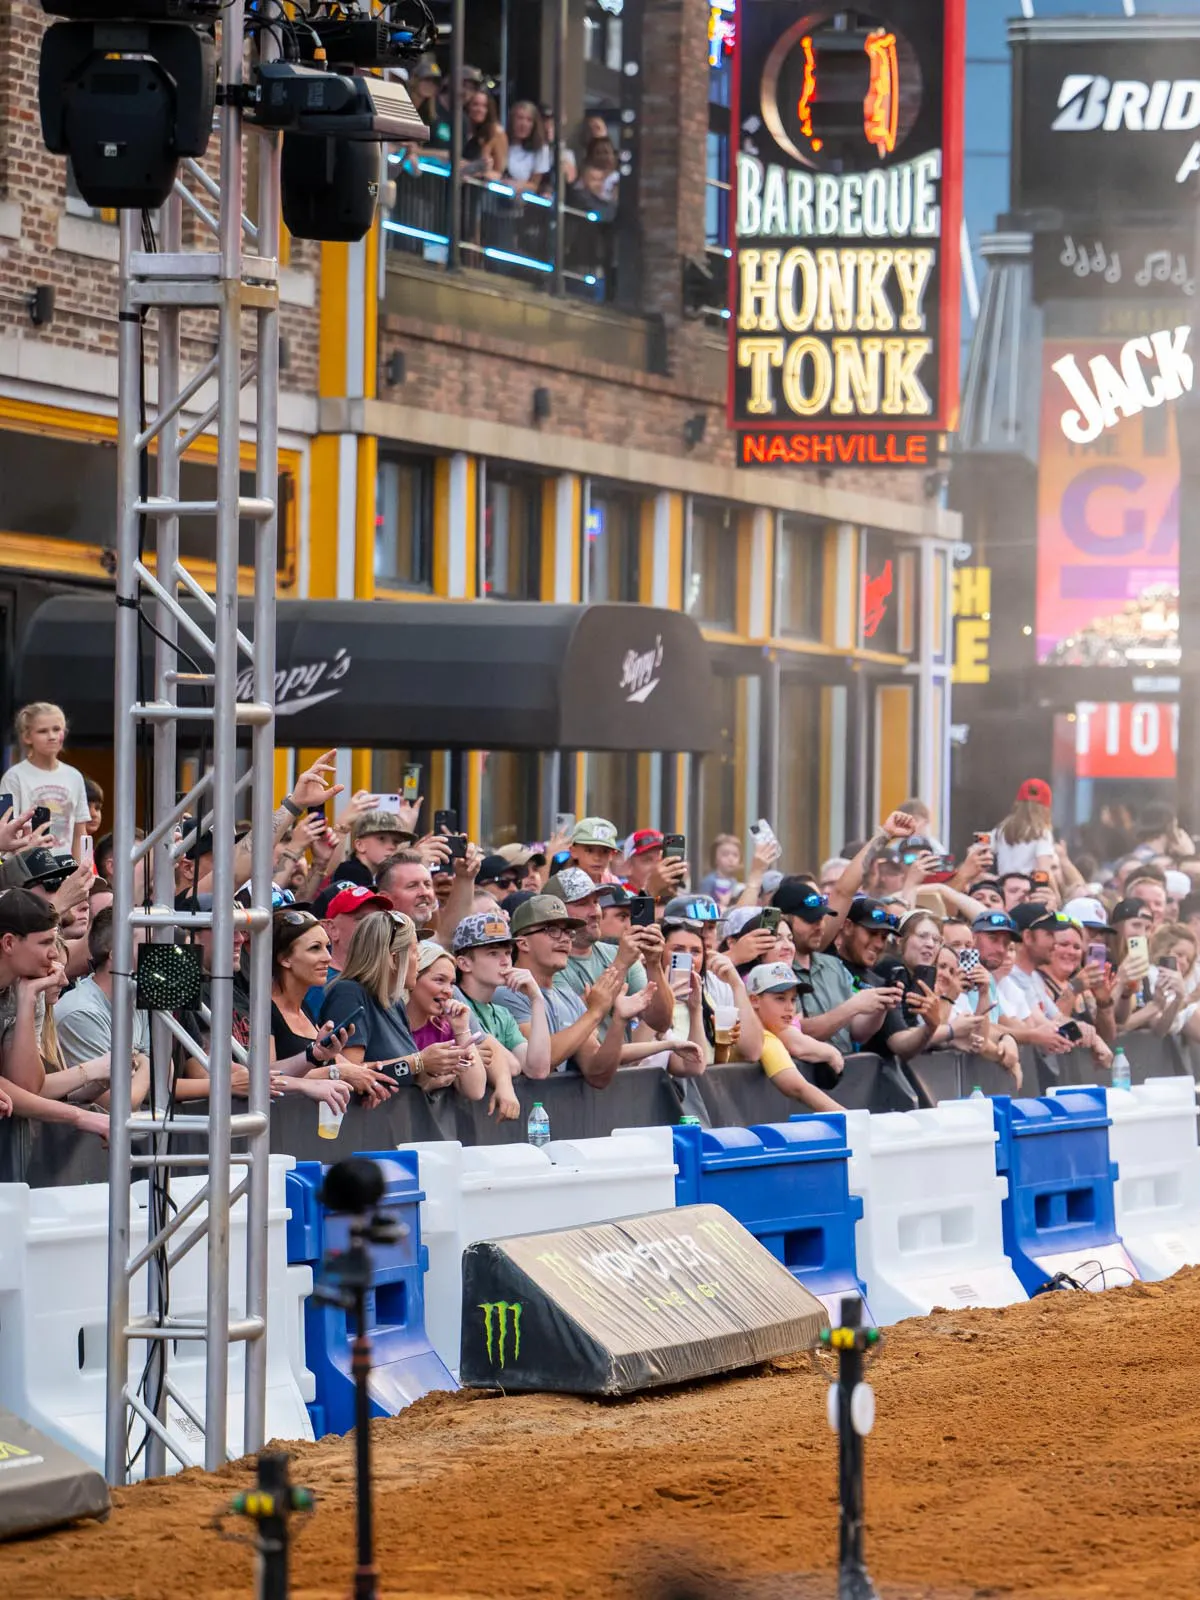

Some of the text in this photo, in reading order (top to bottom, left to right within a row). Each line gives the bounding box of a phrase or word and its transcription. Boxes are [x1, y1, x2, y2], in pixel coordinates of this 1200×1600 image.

[736, 147, 943, 238] BARBEQUE
[738, 246, 935, 332] HONKY
[738, 336, 932, 415] TONK
[1052, 325, 1194, 444] JACK
[742, 434, 928, 463] NASHVILLE
